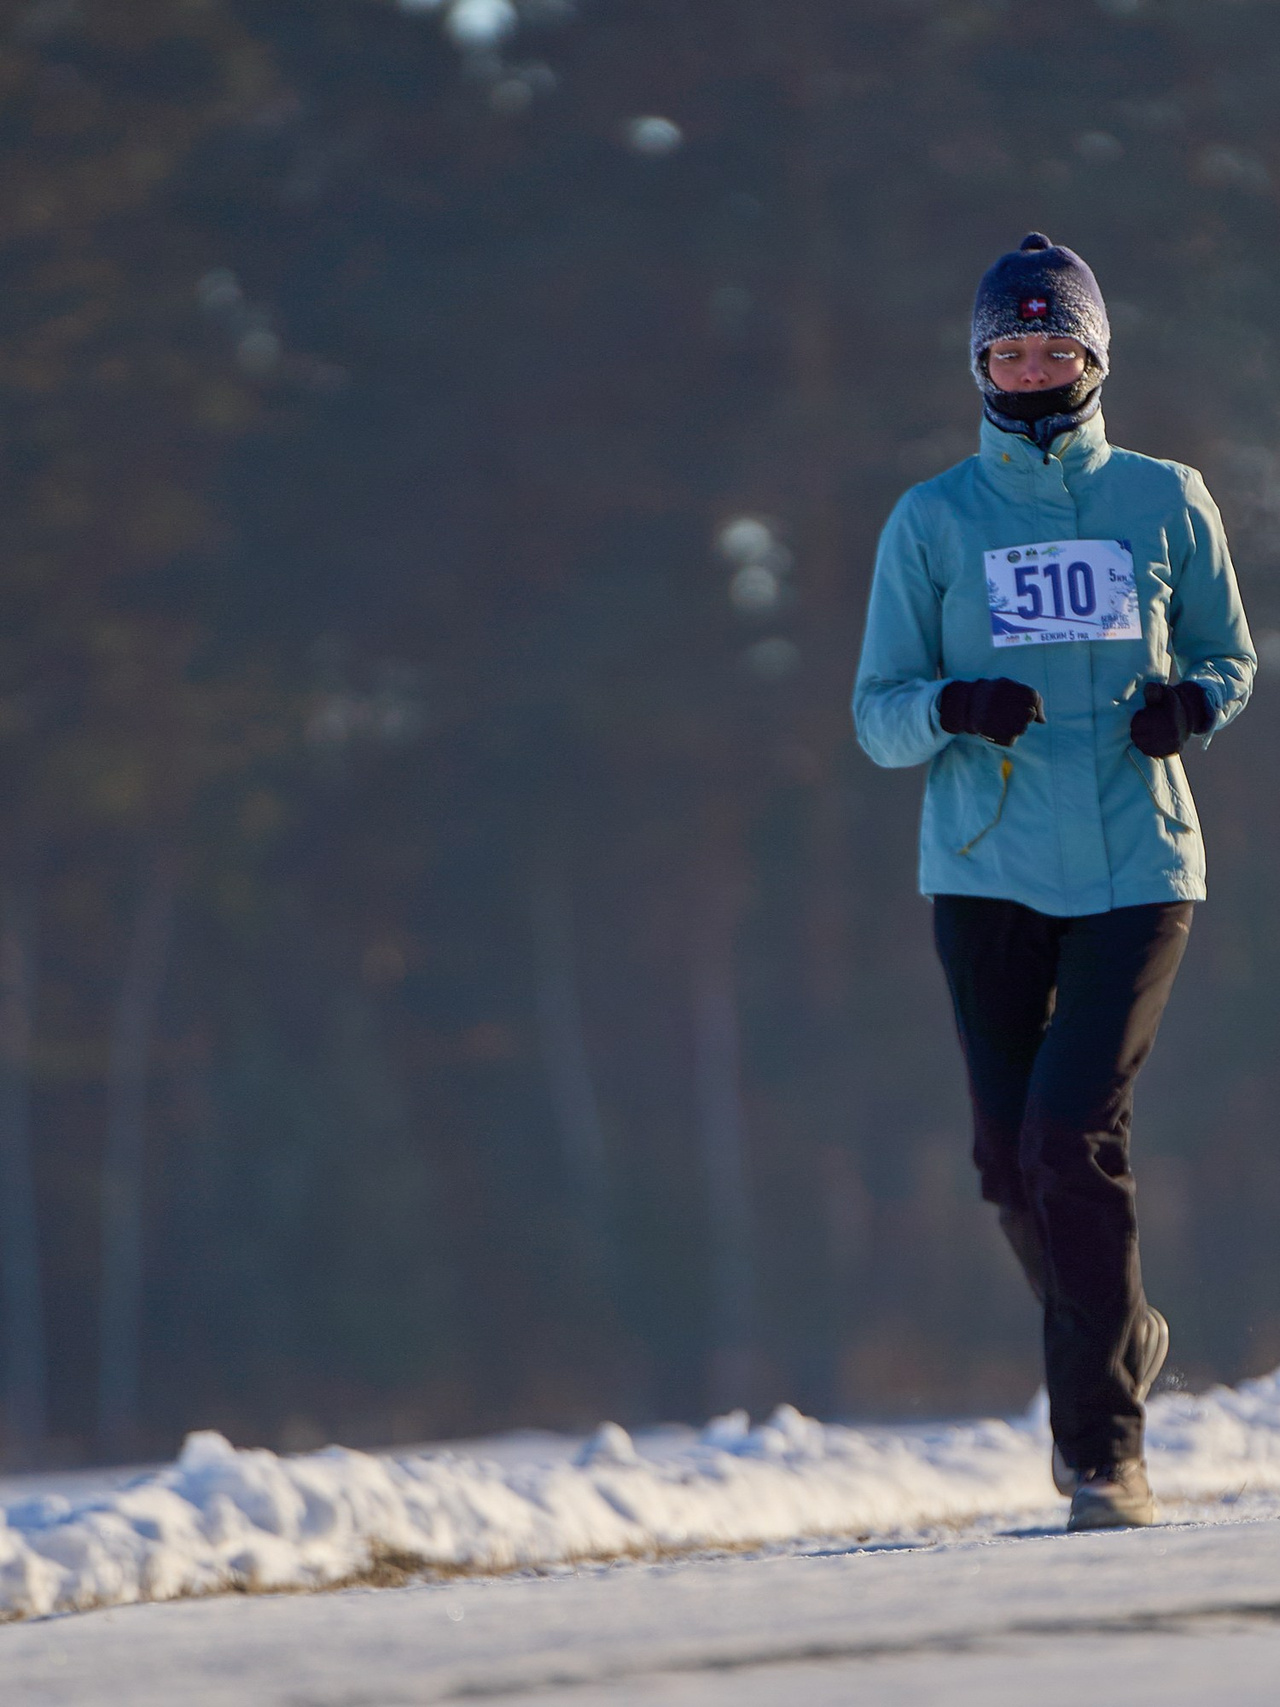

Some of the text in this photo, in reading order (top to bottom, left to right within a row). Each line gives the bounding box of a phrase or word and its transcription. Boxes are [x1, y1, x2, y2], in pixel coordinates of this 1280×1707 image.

[1014, 561, 1097, 620] 510
[1040, 631, 1068, 642] БЕЖИМ
[1069, 629, 1076, 641] 5
